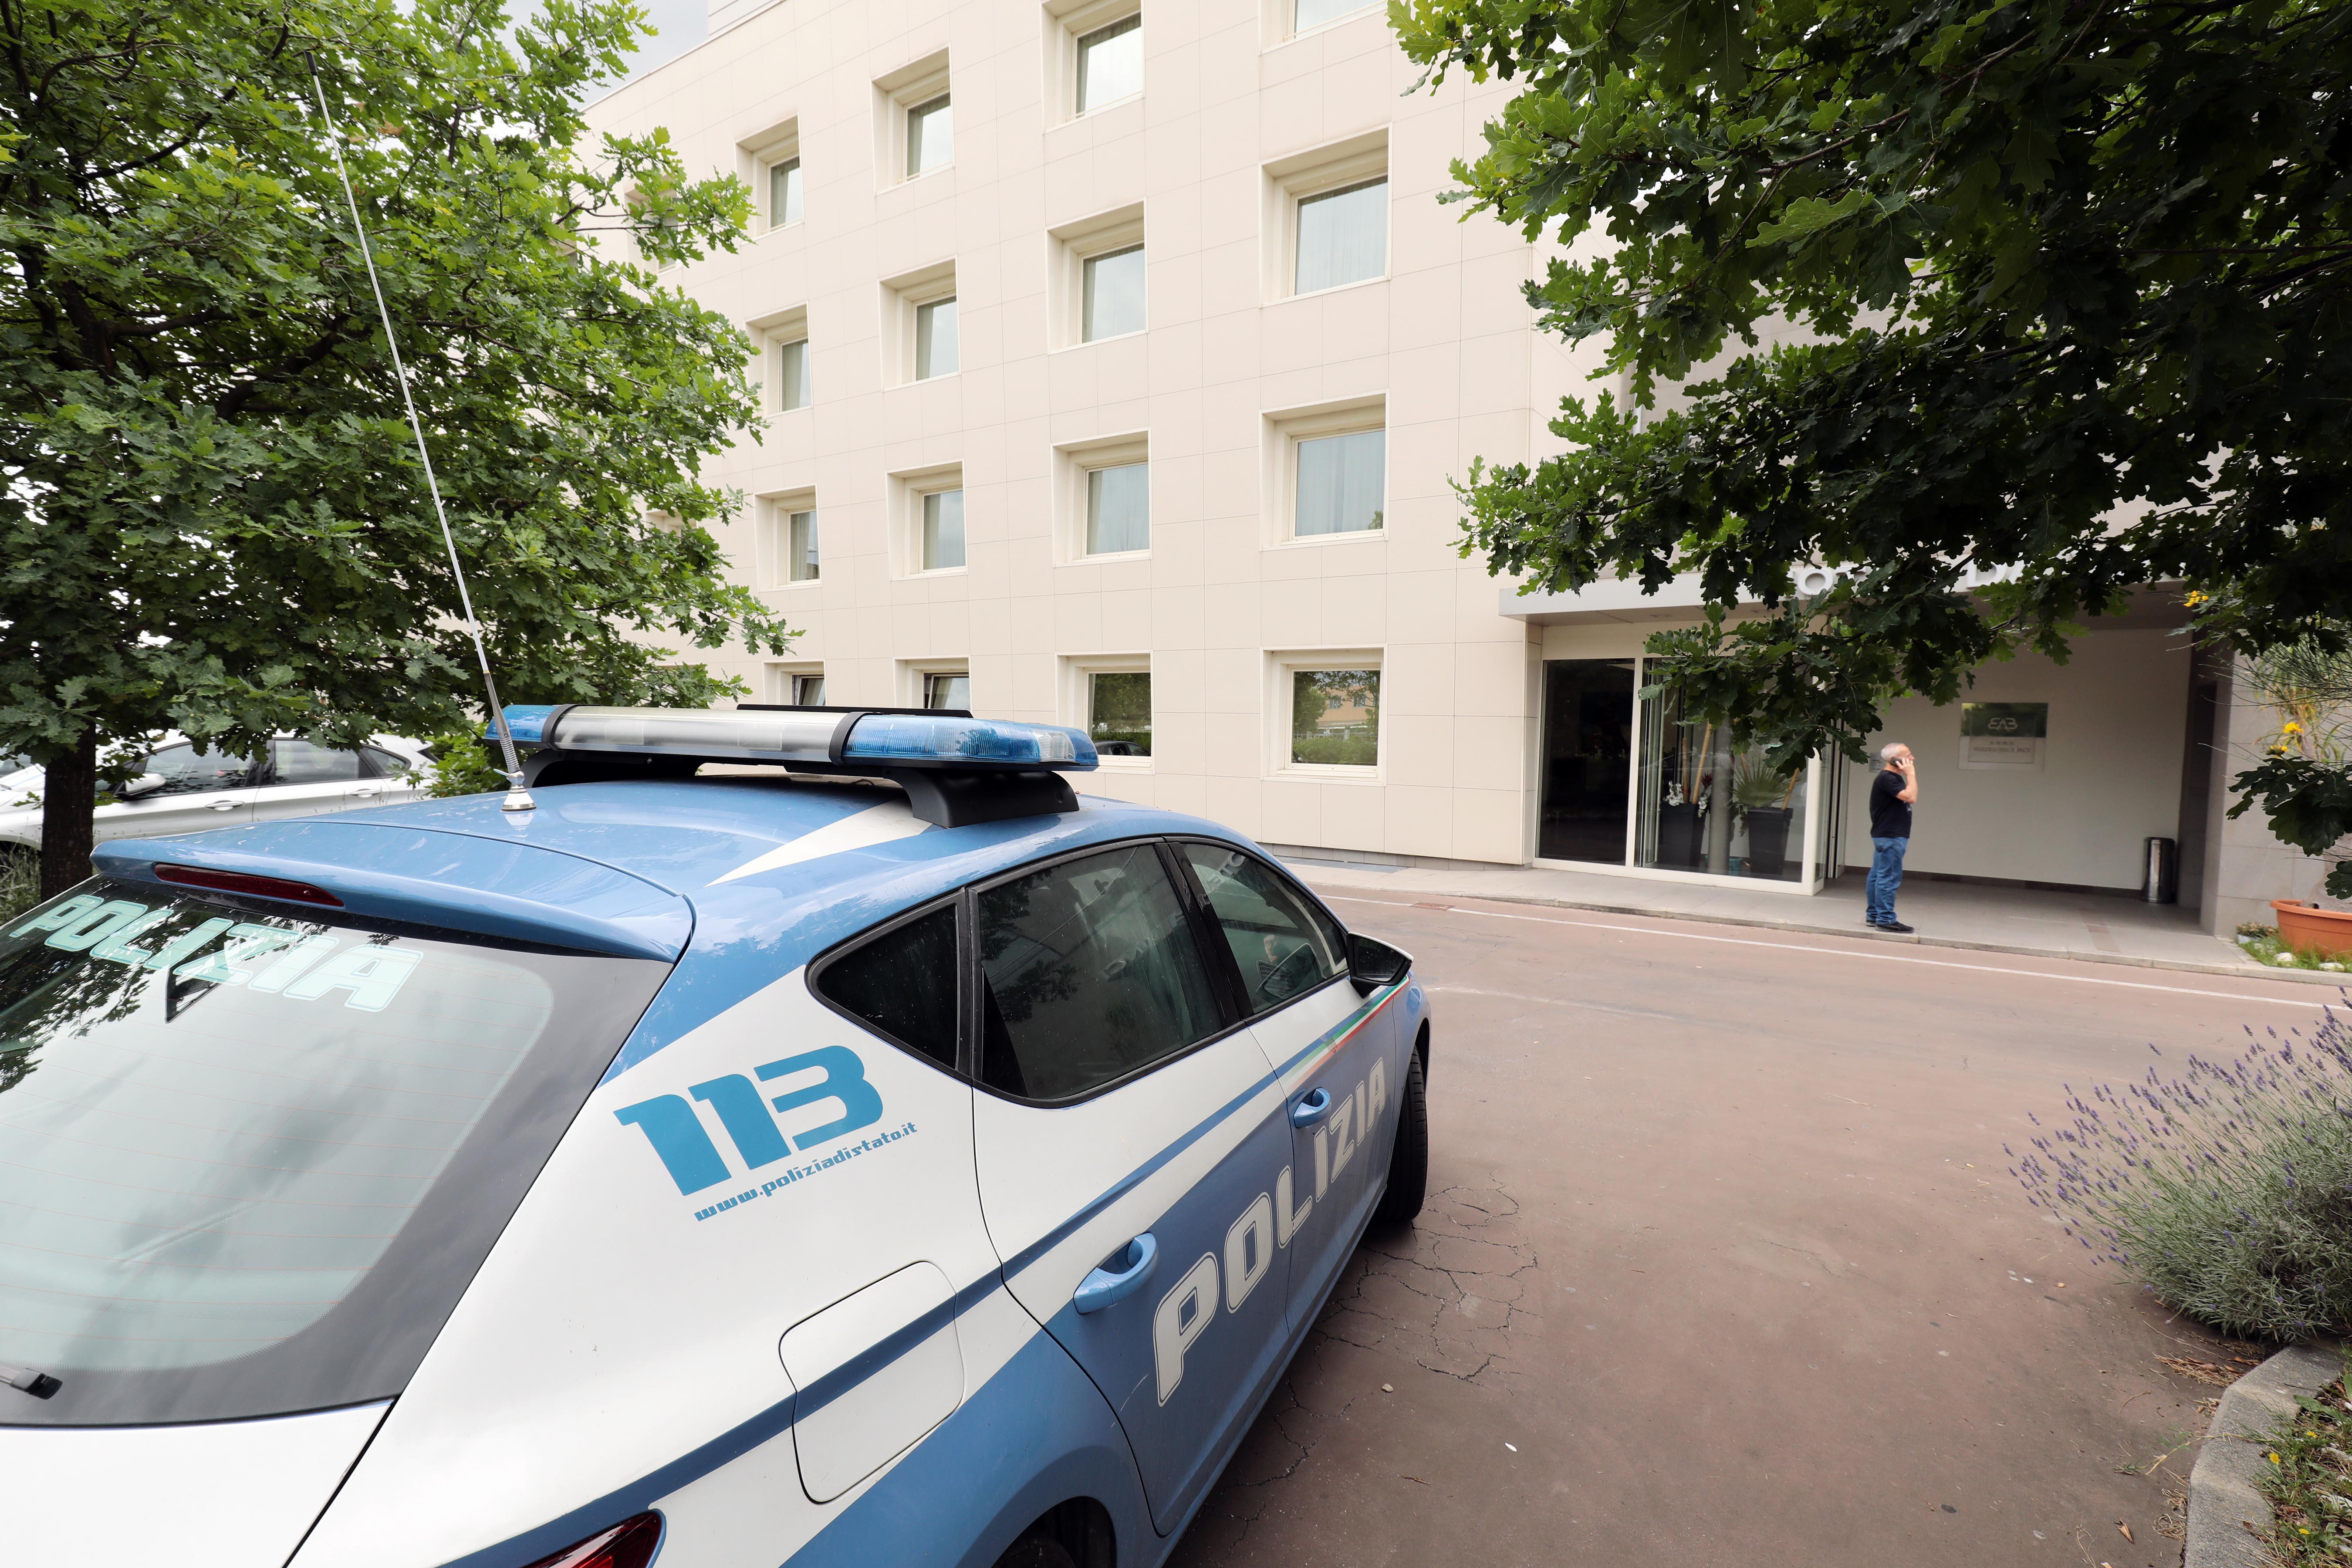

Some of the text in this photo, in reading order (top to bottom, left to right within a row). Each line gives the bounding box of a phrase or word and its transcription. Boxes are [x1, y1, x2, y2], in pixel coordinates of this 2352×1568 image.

[10, 894, 424, 1011] POLIZIA
[613, 1045, 883, 1196] 113
[694, 1122, 918, 1221] www.poliziadistato.it
[1154, 1057, 1386, 1407] POLIZIA
